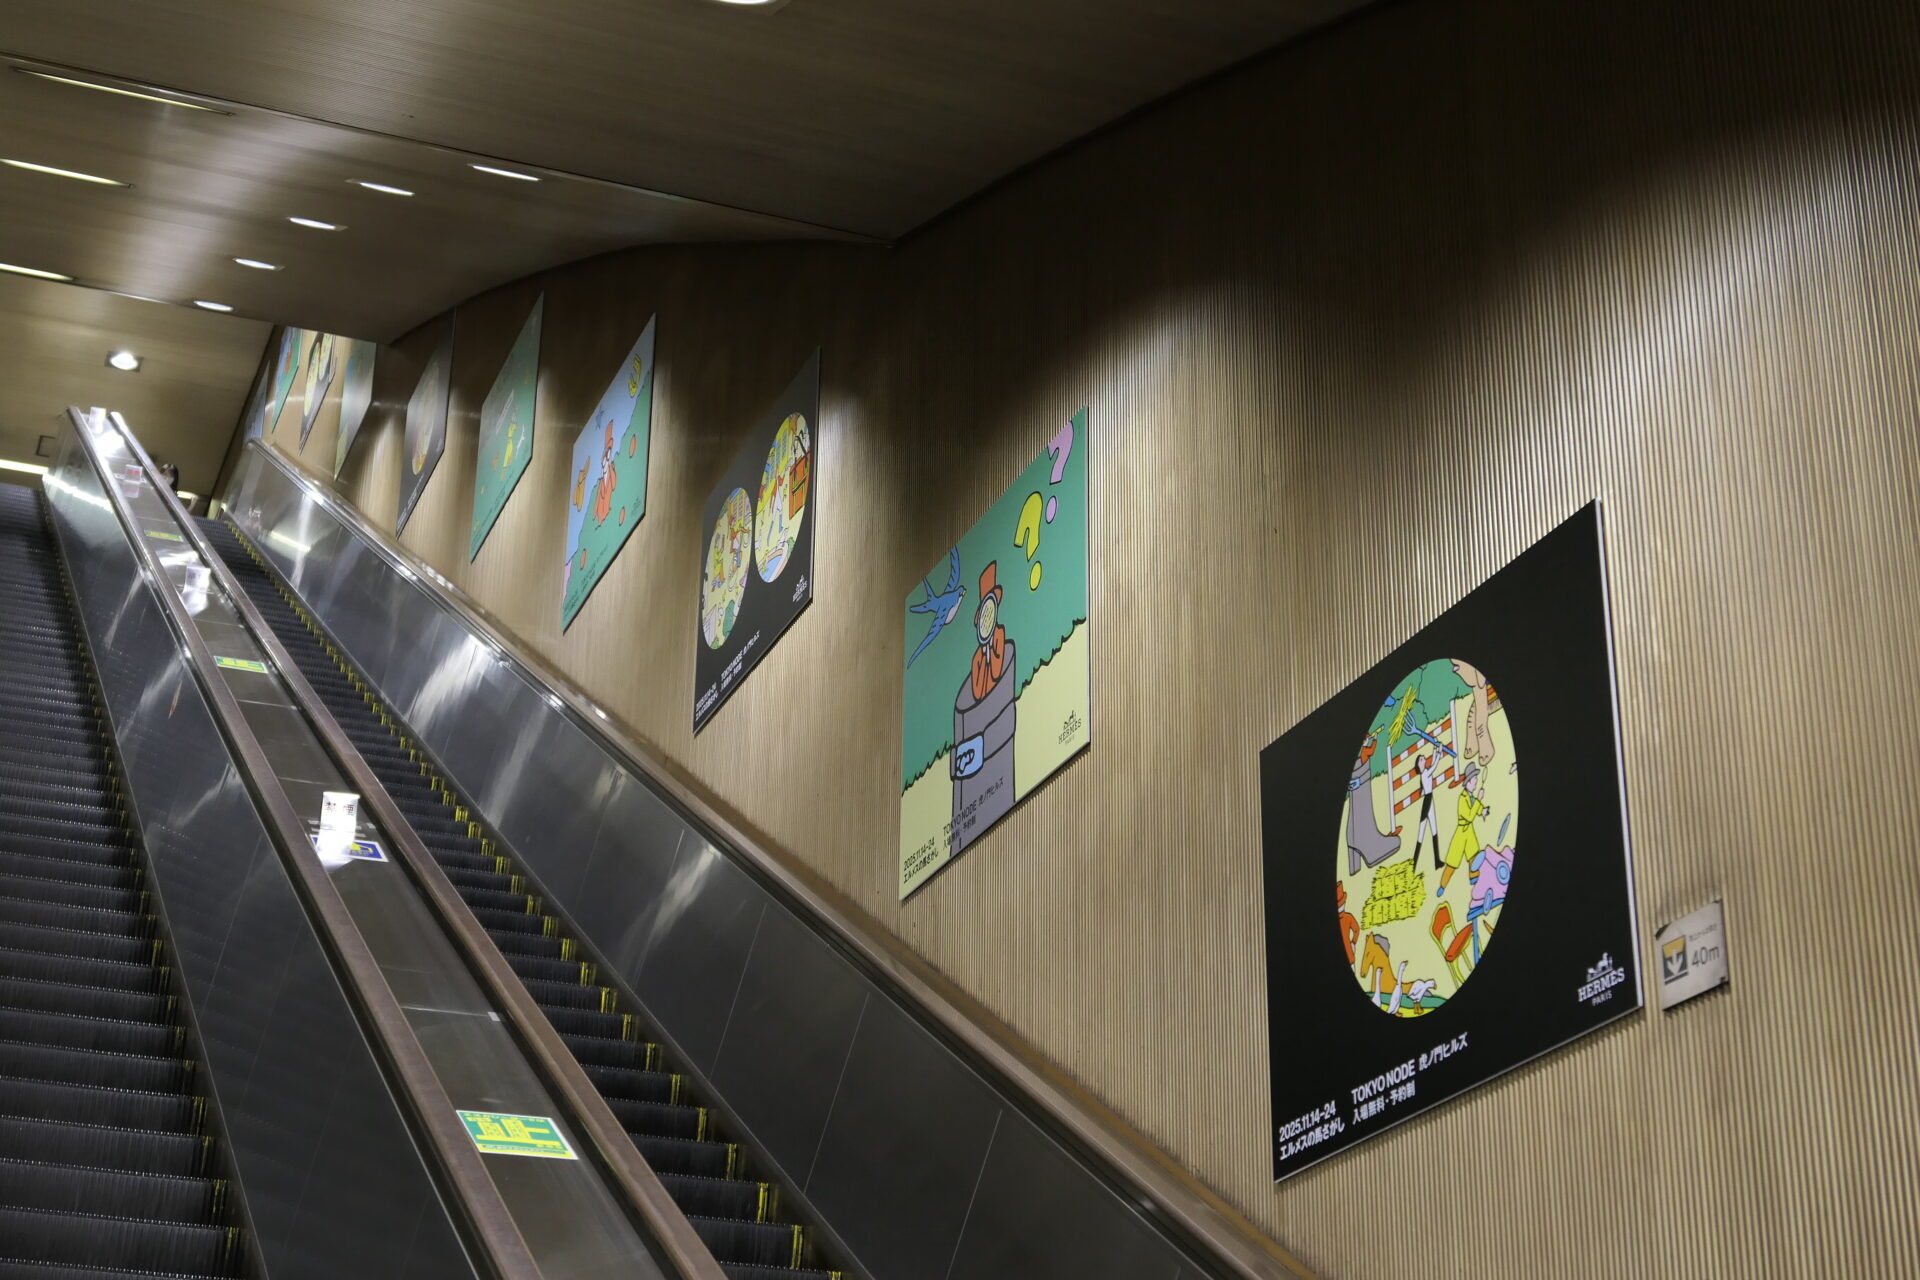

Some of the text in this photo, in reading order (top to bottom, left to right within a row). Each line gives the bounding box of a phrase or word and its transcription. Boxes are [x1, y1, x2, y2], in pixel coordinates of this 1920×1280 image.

[1692, 946, 1720, 968] 40m
[1592, 990, 1612, 1006] PARIS
[1351, 1031, 1468, 1105] TOKYO NODE 虎ノ門ヒルズ
